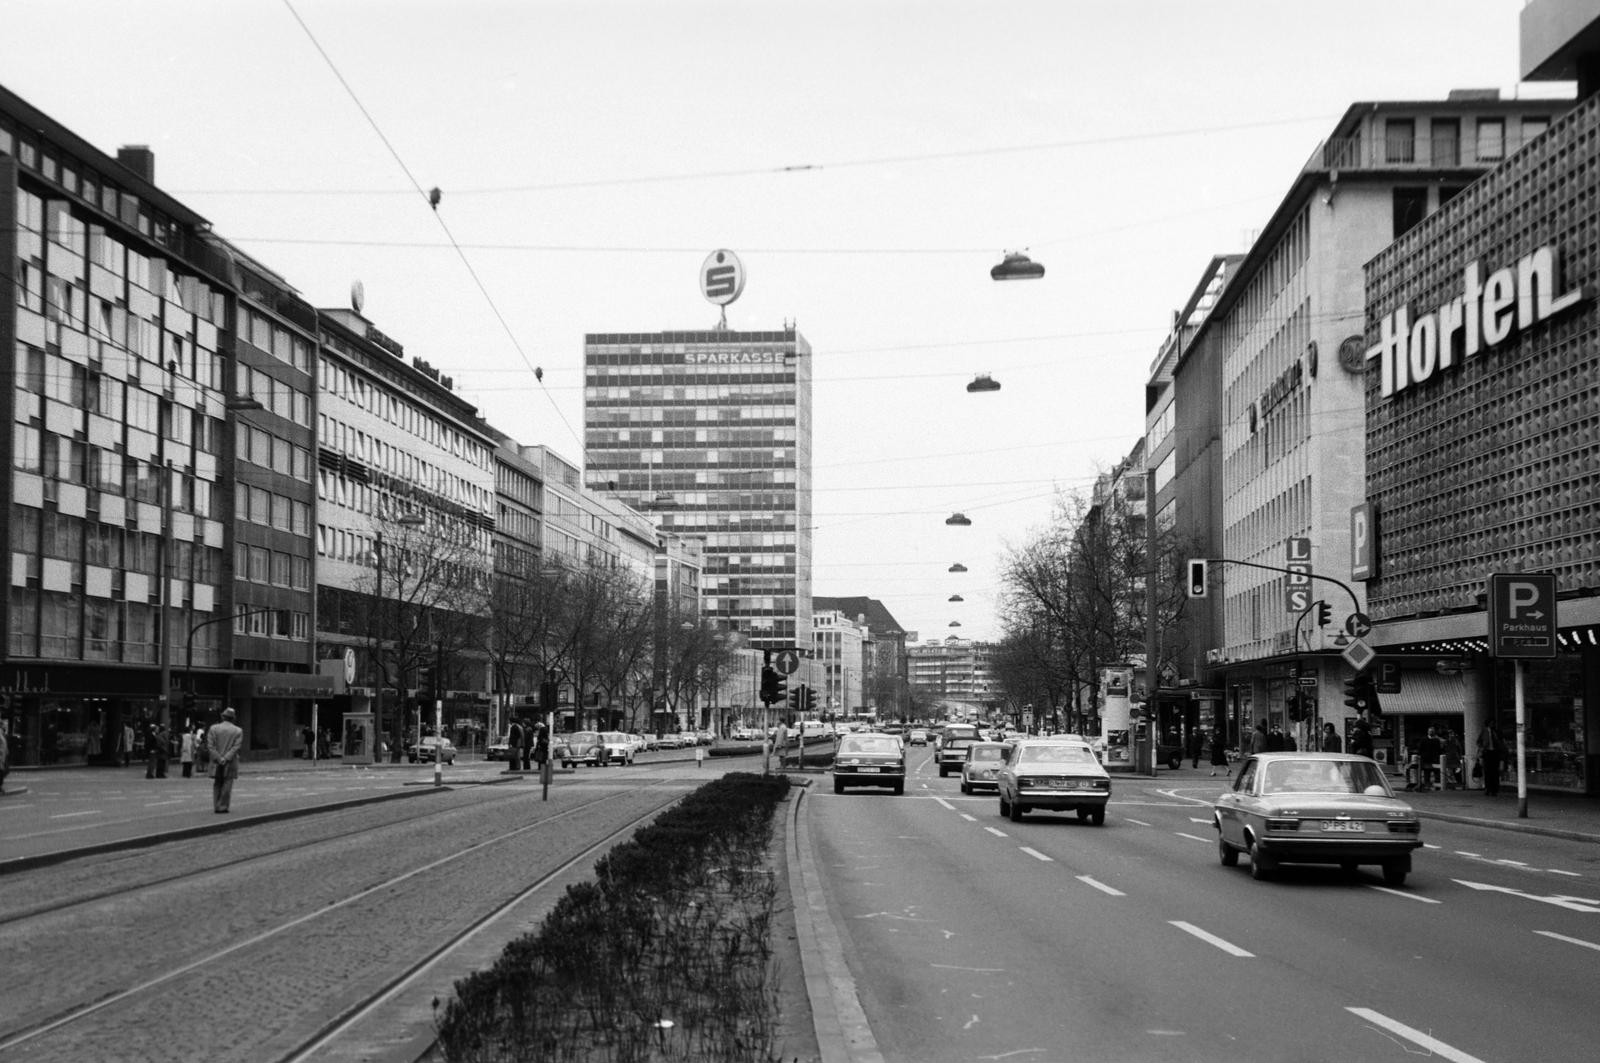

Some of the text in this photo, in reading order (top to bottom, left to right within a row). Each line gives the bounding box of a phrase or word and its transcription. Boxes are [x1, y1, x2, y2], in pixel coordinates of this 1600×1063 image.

[1366, 245, 1582, 399] Horten
[685, 352, 785, 364] SPARKASSE
[1354, 511, 1366, 566] P
[1290, 540, 1309, 610] LBS
[1509, 582, 1540, 619] P
[1503, 623, 1547, 632] Parkhaus
